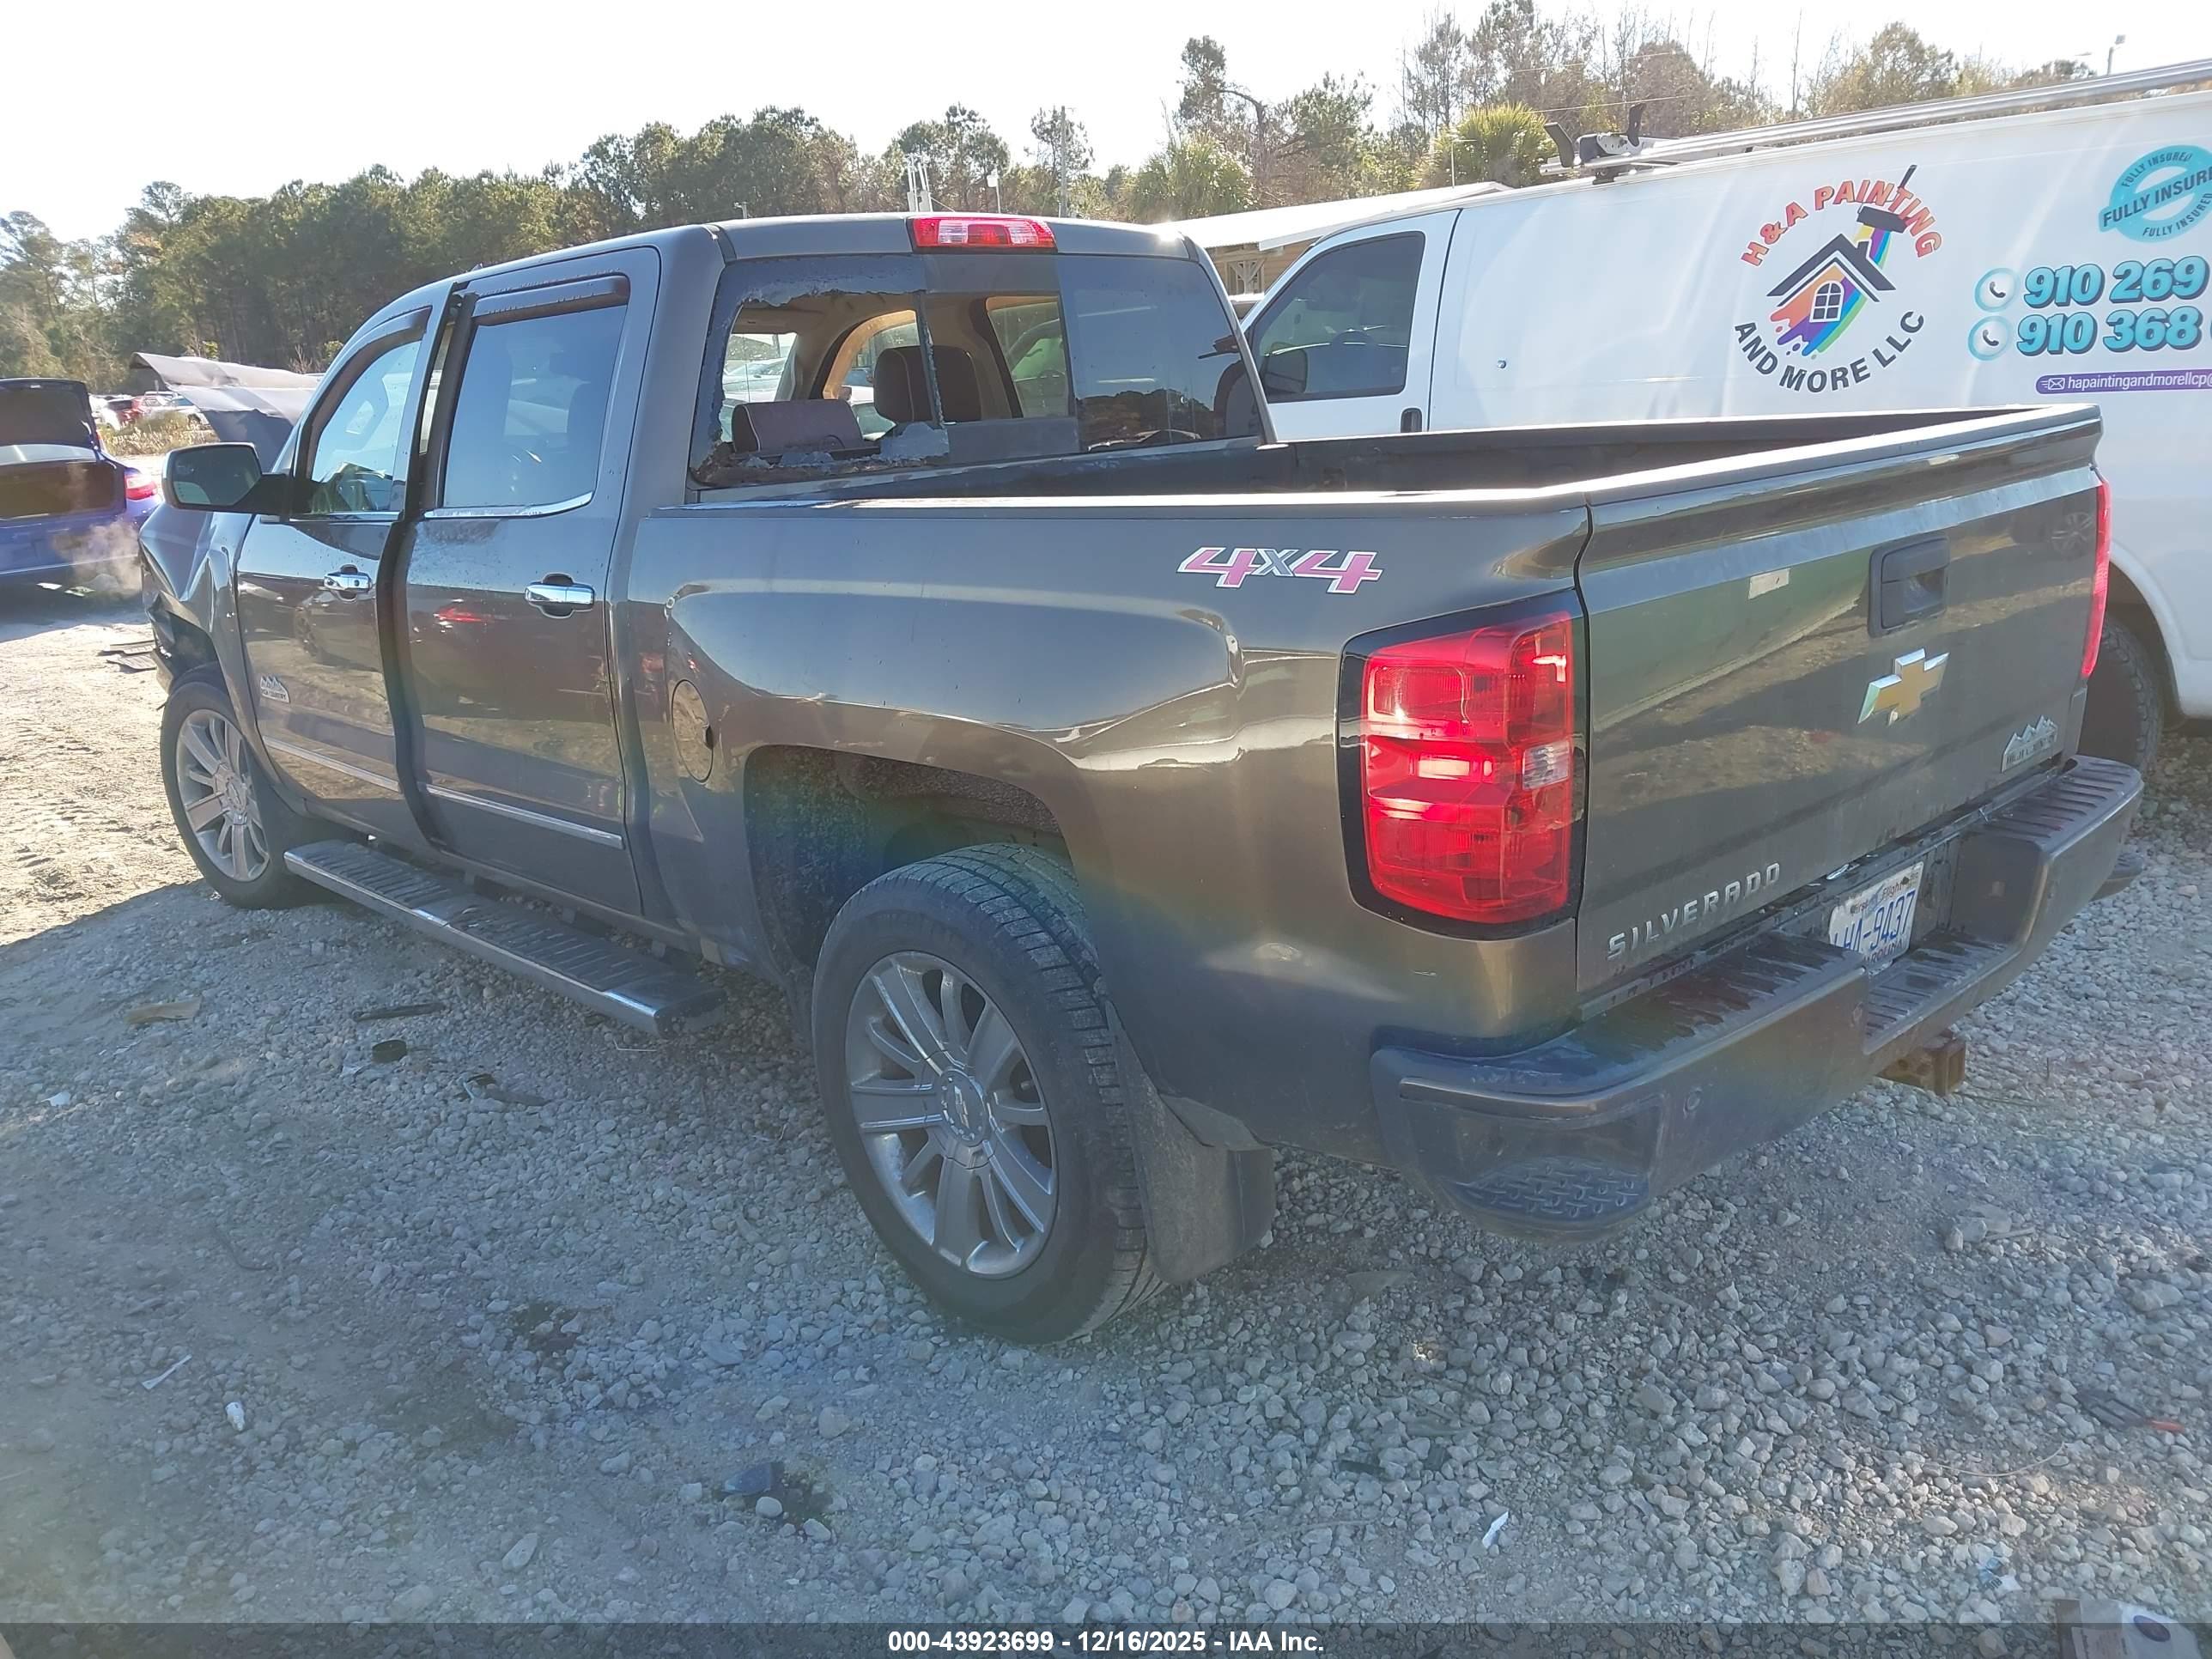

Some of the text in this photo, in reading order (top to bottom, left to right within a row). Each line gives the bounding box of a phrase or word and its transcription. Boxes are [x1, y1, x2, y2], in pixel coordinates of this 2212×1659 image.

[2121, 152, 2193, 187] FULLY INSURED
[1741, 179, 1942, 266] H&A PAINTING
[2103, 194, 2150, 227] FULLY
[2142, 225, 2172, 237] FULLY
[2024, 255, 2209, 308] 910 269
[1735, 311, 1924, 392] AND MORE LLC
[2016, 311, 2097, 356] 910
[2103, 306, 2203, 353] 368
[1607, 862, 1780, 961] SILVERADO
[1834, 889, 1917, 952] HA-9437
